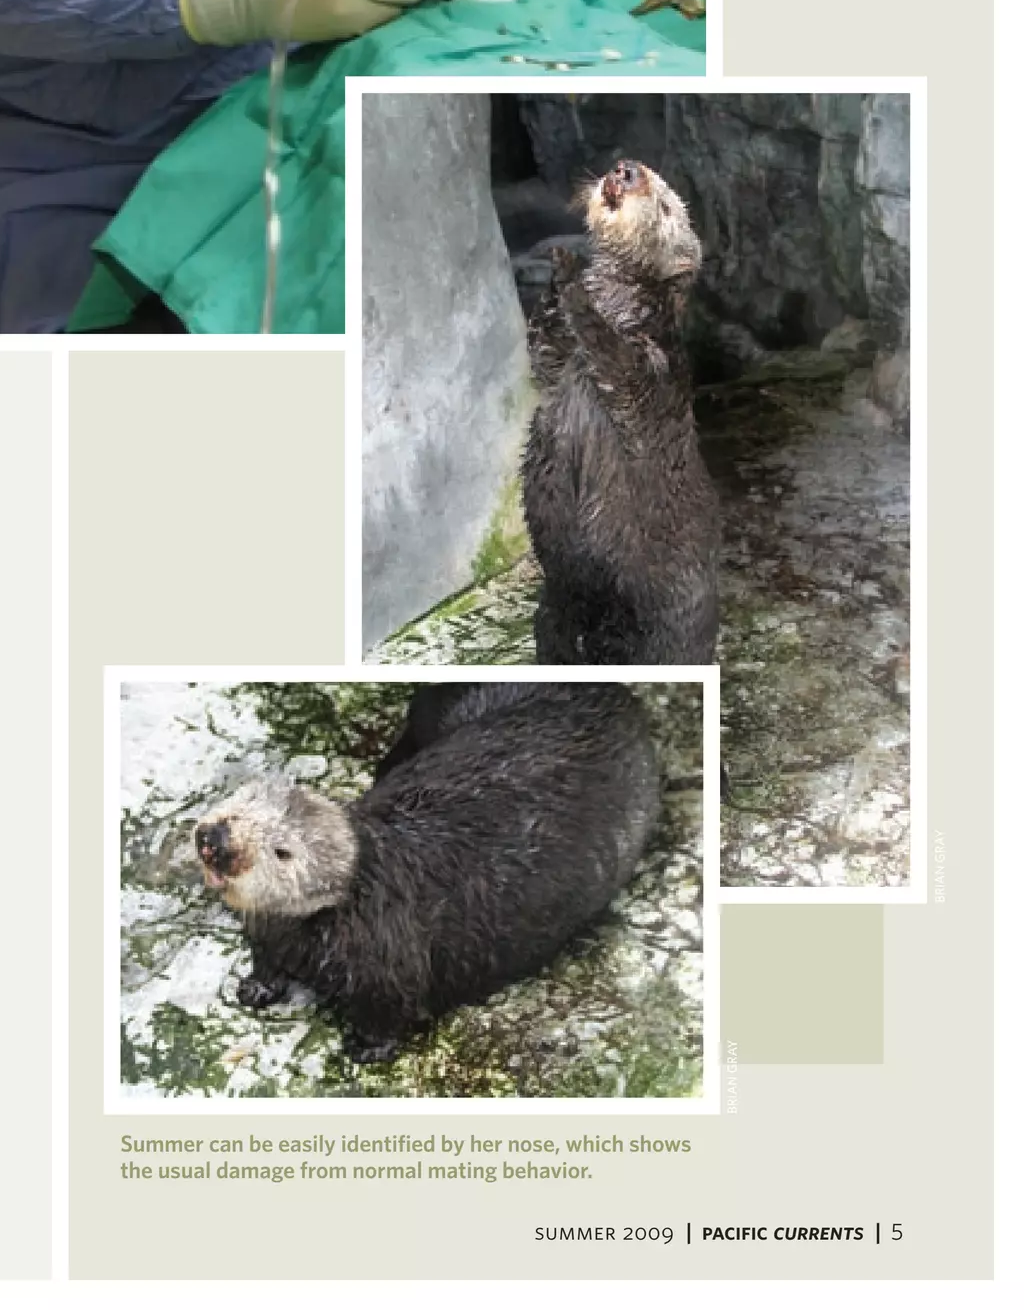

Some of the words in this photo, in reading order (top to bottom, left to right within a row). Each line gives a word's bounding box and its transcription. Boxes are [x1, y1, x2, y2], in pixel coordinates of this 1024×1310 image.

[934, 828, 945, 863] GRAY
[934, 865, 945, 903] BRIAN
[727, 1039, 737, 1073] GRAY
[727, 1076, 737, 1114] BRIAN
[121, 1135, 203, 1152] Summer
[210, 1140, 243, 1152] can
[250, 1135, 273, 1152] be
[279, 1135, 335, 1156] easily
[342, 1135, 434, 1152] identified
[442, 1135, 464, 1156] by
[471, 1135, 502, 1152] her
[509, 1140, 559, 1155] nose,
[566, 1135, 623, 1152] which
[630, 1135, 691, 1152] shows
[121, 1161, 152, 1179] the
[159, 1161, 210, 1179] usual
[217, 1161, 294, 1182] damage
[300, 1161, 346, 1178] from
[354, 1161, 421, 1179] normal
[429, 1162, 497, 1182] mating
[503, 1161, 592, 1179] behavior.
[535, 1227, 615, 1240] SUMMER
[623, 1227, 673, 1244] 2009
[703, 1227, 767, 1240] PACIFIC
[774, 1227, 863, 1240] CURRENTS
[892, 1224, 902, 1240] 5
